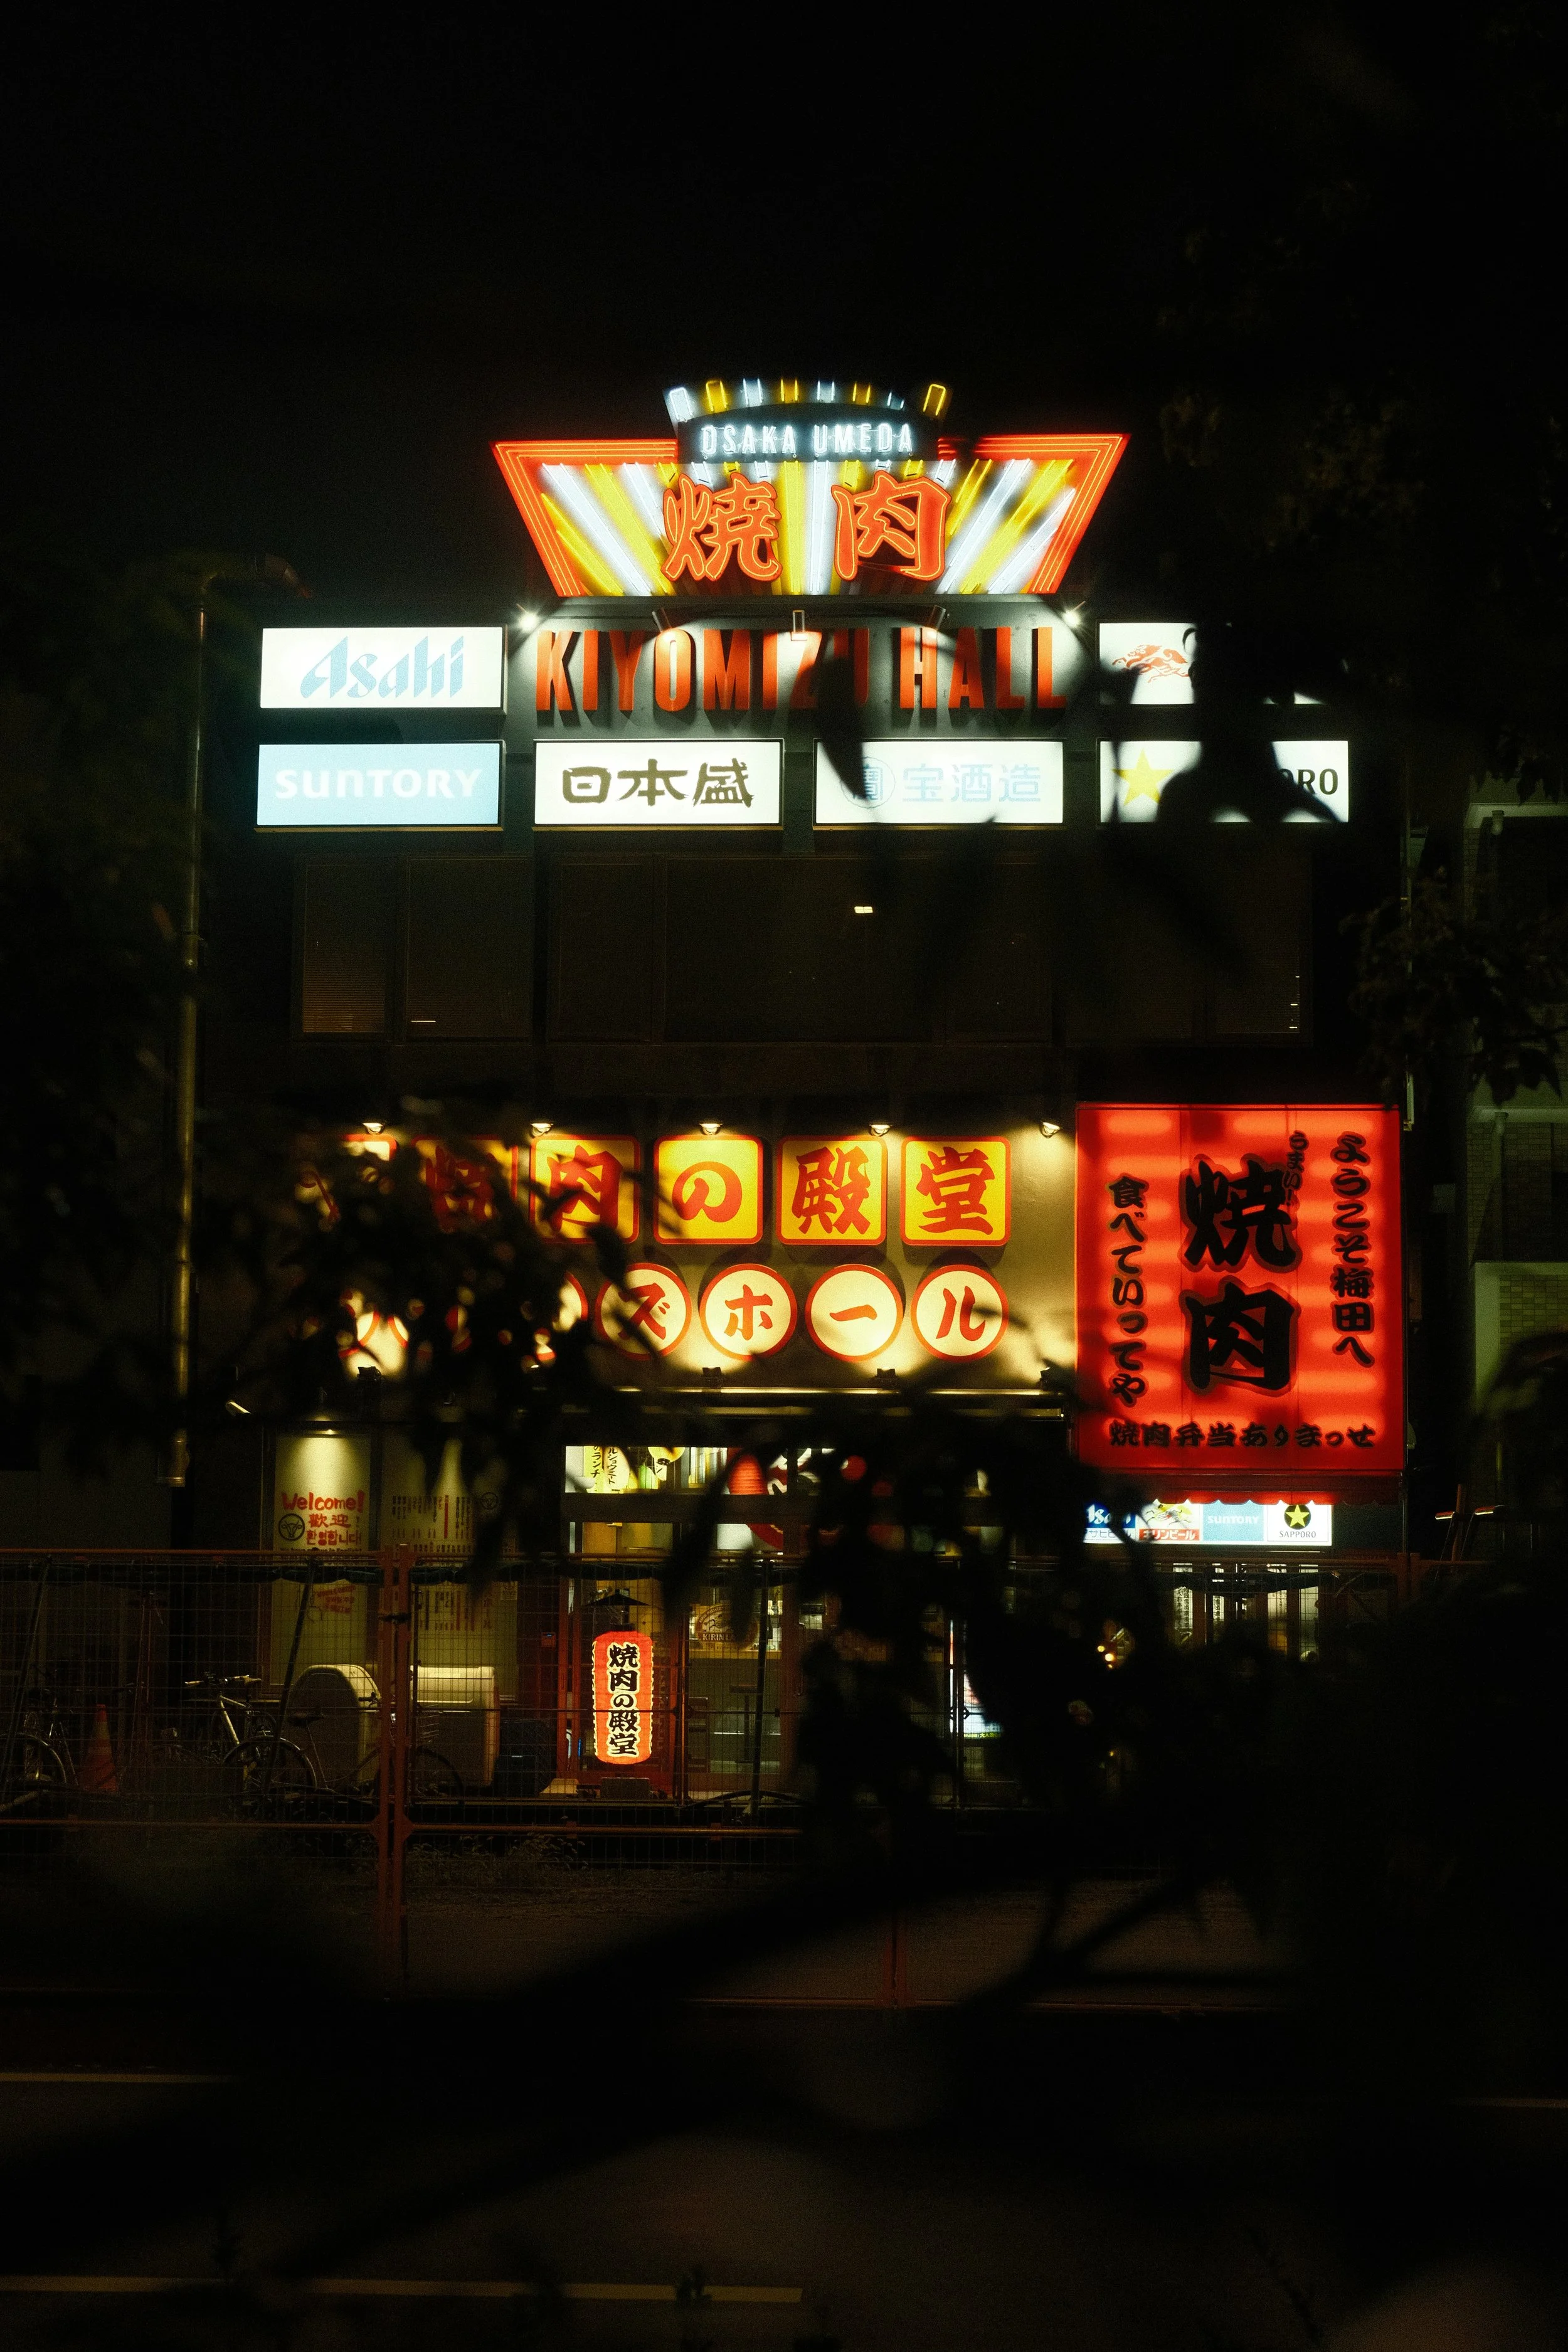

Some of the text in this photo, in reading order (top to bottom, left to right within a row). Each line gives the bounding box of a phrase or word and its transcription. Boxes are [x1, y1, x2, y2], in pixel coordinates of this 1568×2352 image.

[701, 422, 913, 454] OSAKA UMEDA
[663, 470, 951, 581] 焼肉
[300, 636, 464, 698] Asahi
[536, 626, 1066, 710] KIYOMIZU HALL
[275, 768, 482, 800] SUNTORY
[563, 759, 753, 808] 日本盛
[903, 763, 1041, 803] 宝酒造
[1185, 1158, 1297, 1389] 焼肉
[1333, 1135, 1374, 1366] ようこそ梅田へ
[1109, 1177, 1147, 1406] 食べていってや
[1110, 1422, 1375, 1448] 焼肉弁当ありまっせ
[282, 1490, 365, 1513] Welcome!
[609, 1644, 638, 1756] 焼肉の殿堂
